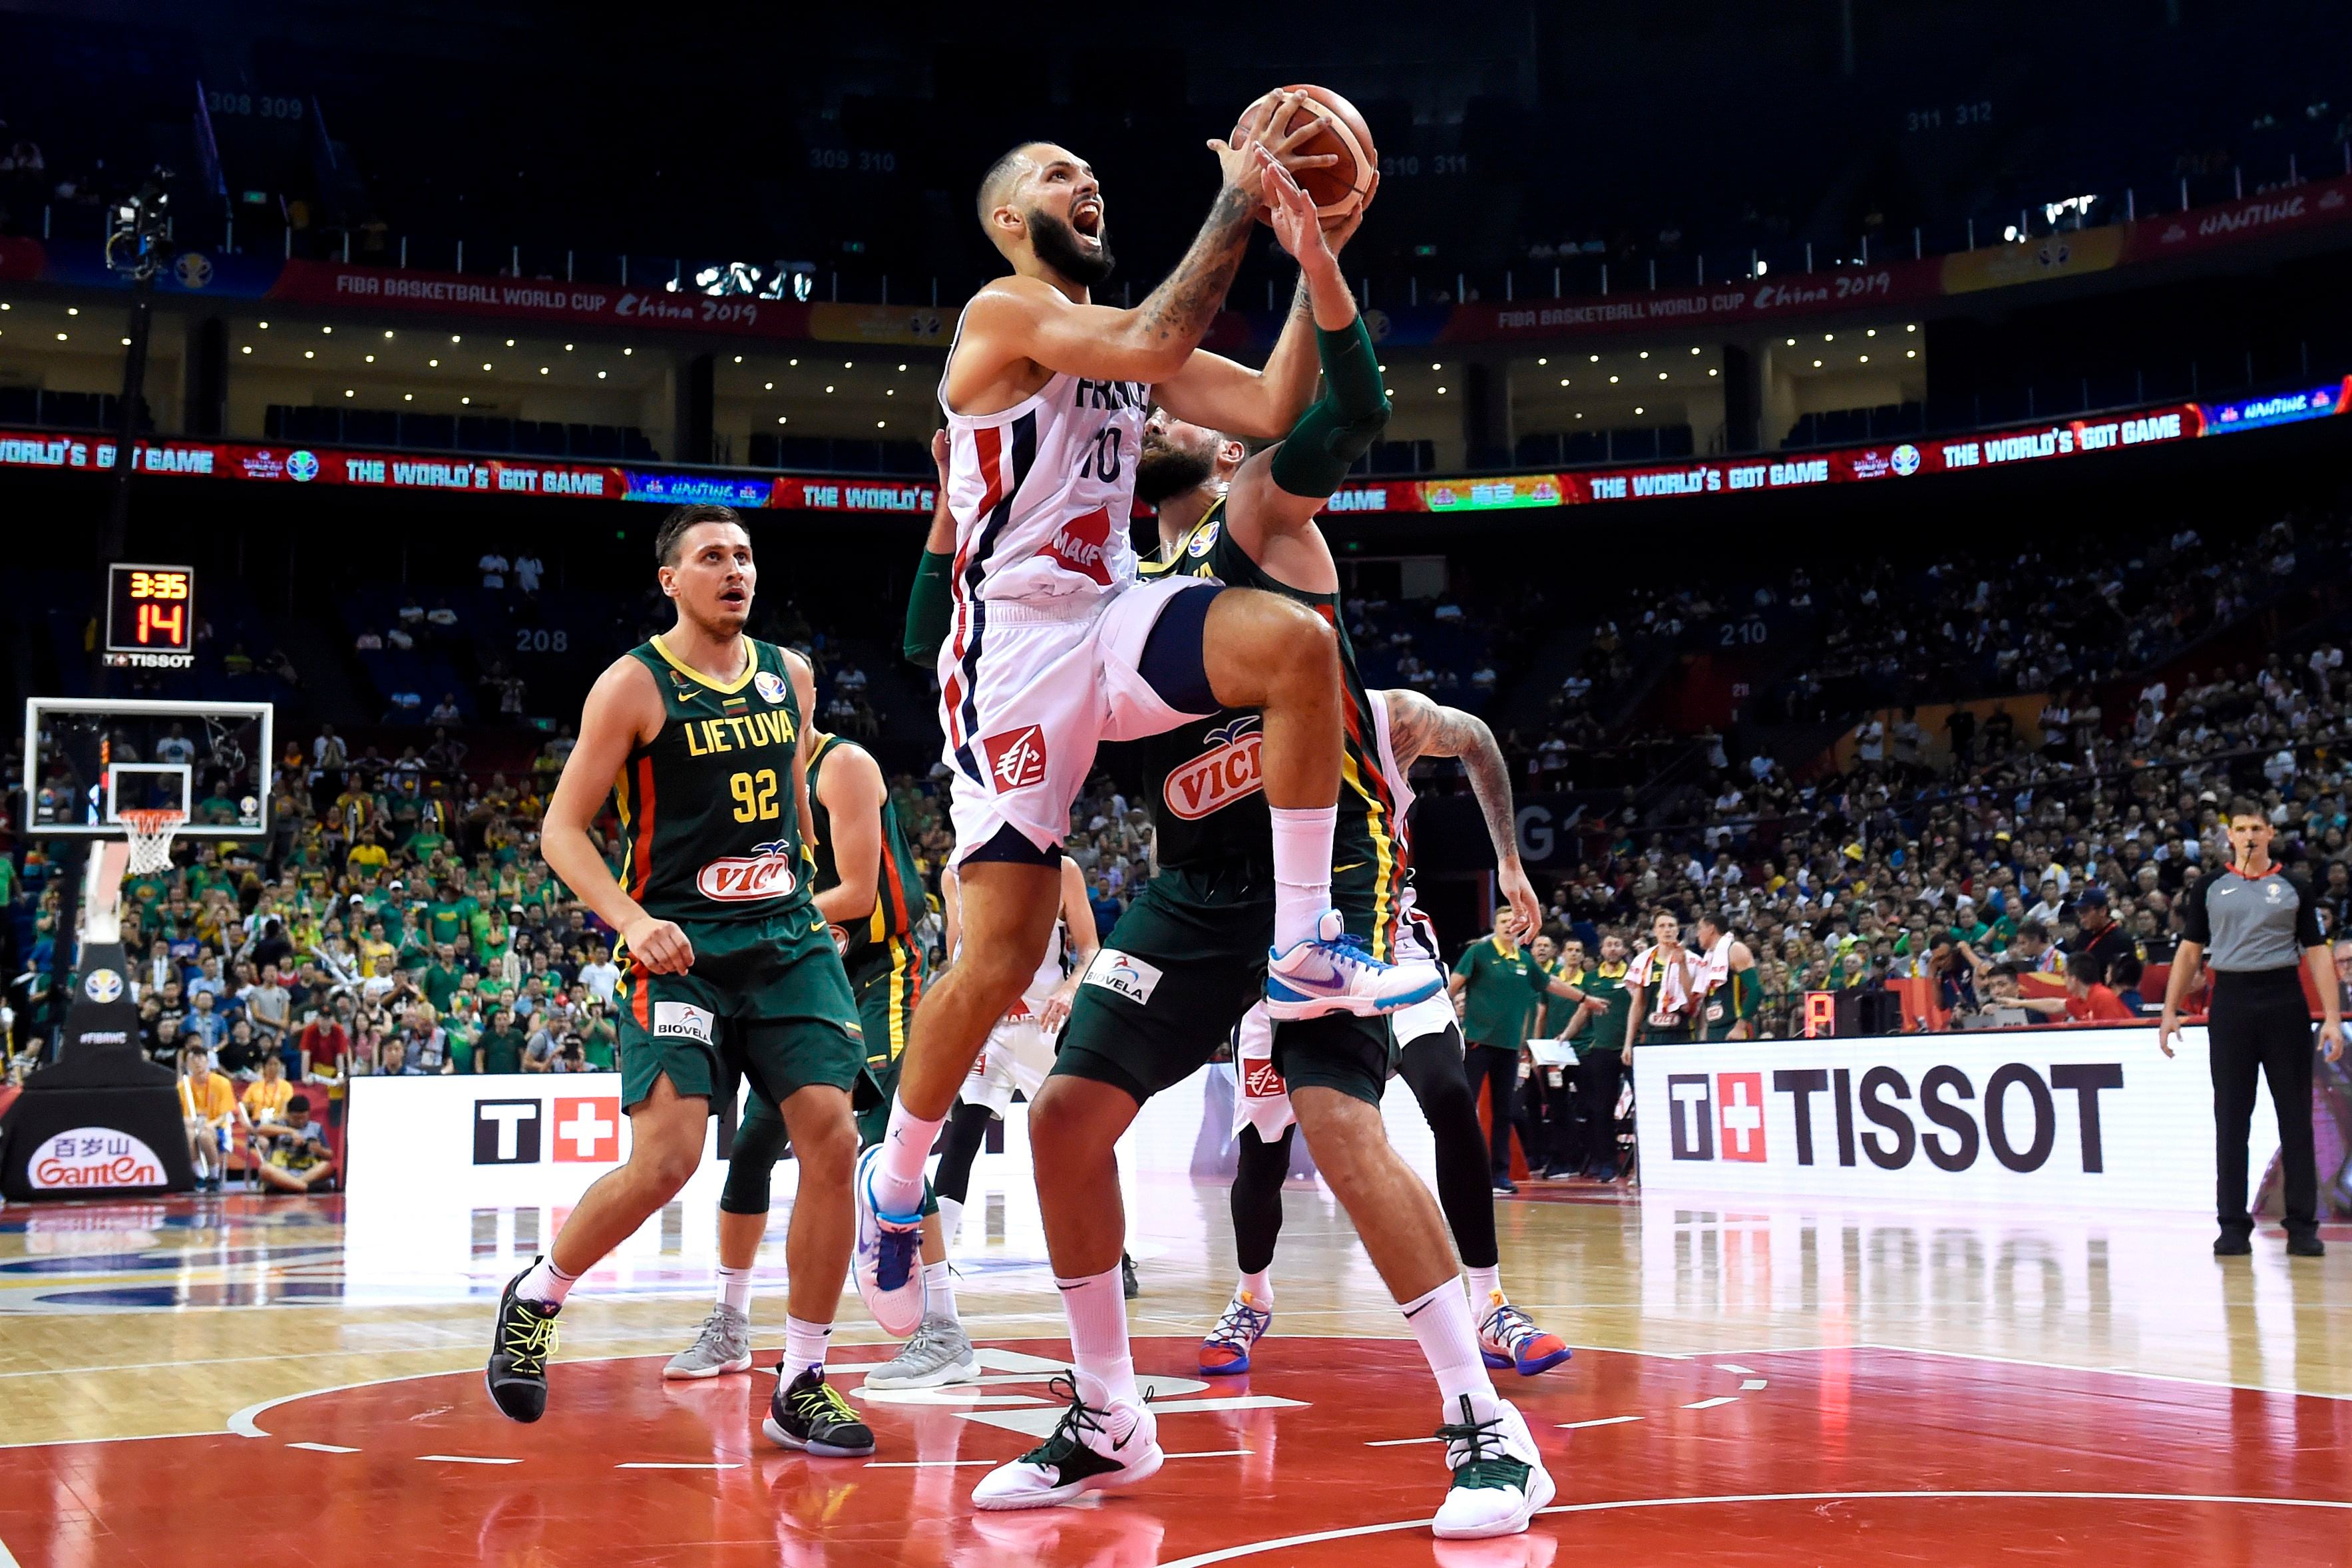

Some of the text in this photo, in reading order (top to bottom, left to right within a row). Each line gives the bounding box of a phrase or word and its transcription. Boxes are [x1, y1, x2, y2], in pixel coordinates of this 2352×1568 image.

[337, 274, 757, 326] FIBA BASKETBALL WORLD CUP China 2019
[1540, 302, 1646, 325] BASKETBALL
[1649, 296, 1708, 317] WORLD
[1711, 293, 1745, 311] CUP
[1753, 285, 1828, 309] China
[1835, 271, 1891, 298] 2019
[97, 444, 142, 469] GT
[145, 447, 214, 473] GAME
[1080, 427, 1121, 484] 10
[1943, 414, 2181, 468] THE WORLD'S GOT GAME
[345, 459, 604, 495] THE WORLD'S GOT GAME
[1590, 477, 1627, 499] THE
[1632, 467, 1721, 496] WORLD'S
[1728, 467, 1766, 489] GOT
[1769, 459, 1828, 486] GAME
[803, 485, 934, 511] THE WORLD'S
[1327, 489, 1387, 511] GAME
[1053, 531, 1099, 567] MAIF
[131, 572, 187, 599] 3:35
[138, 604, 182, 645] 14
[516, 628, 568, 654] 208
[1719, 622, 1768, 646] 210
[128, 654, 195, 668] TISSOT
[684, 709, 795, 757] LIETUVA
[729, 769, 779, 823] 92
[1087, 972, 1143, 1000] BIOVELA
[658, 1024, 710, 1043] BIOVELA
[1773, 1062, 2123, 1174] TISSOT
[55, 1138, 129, 1157] 百岁山
